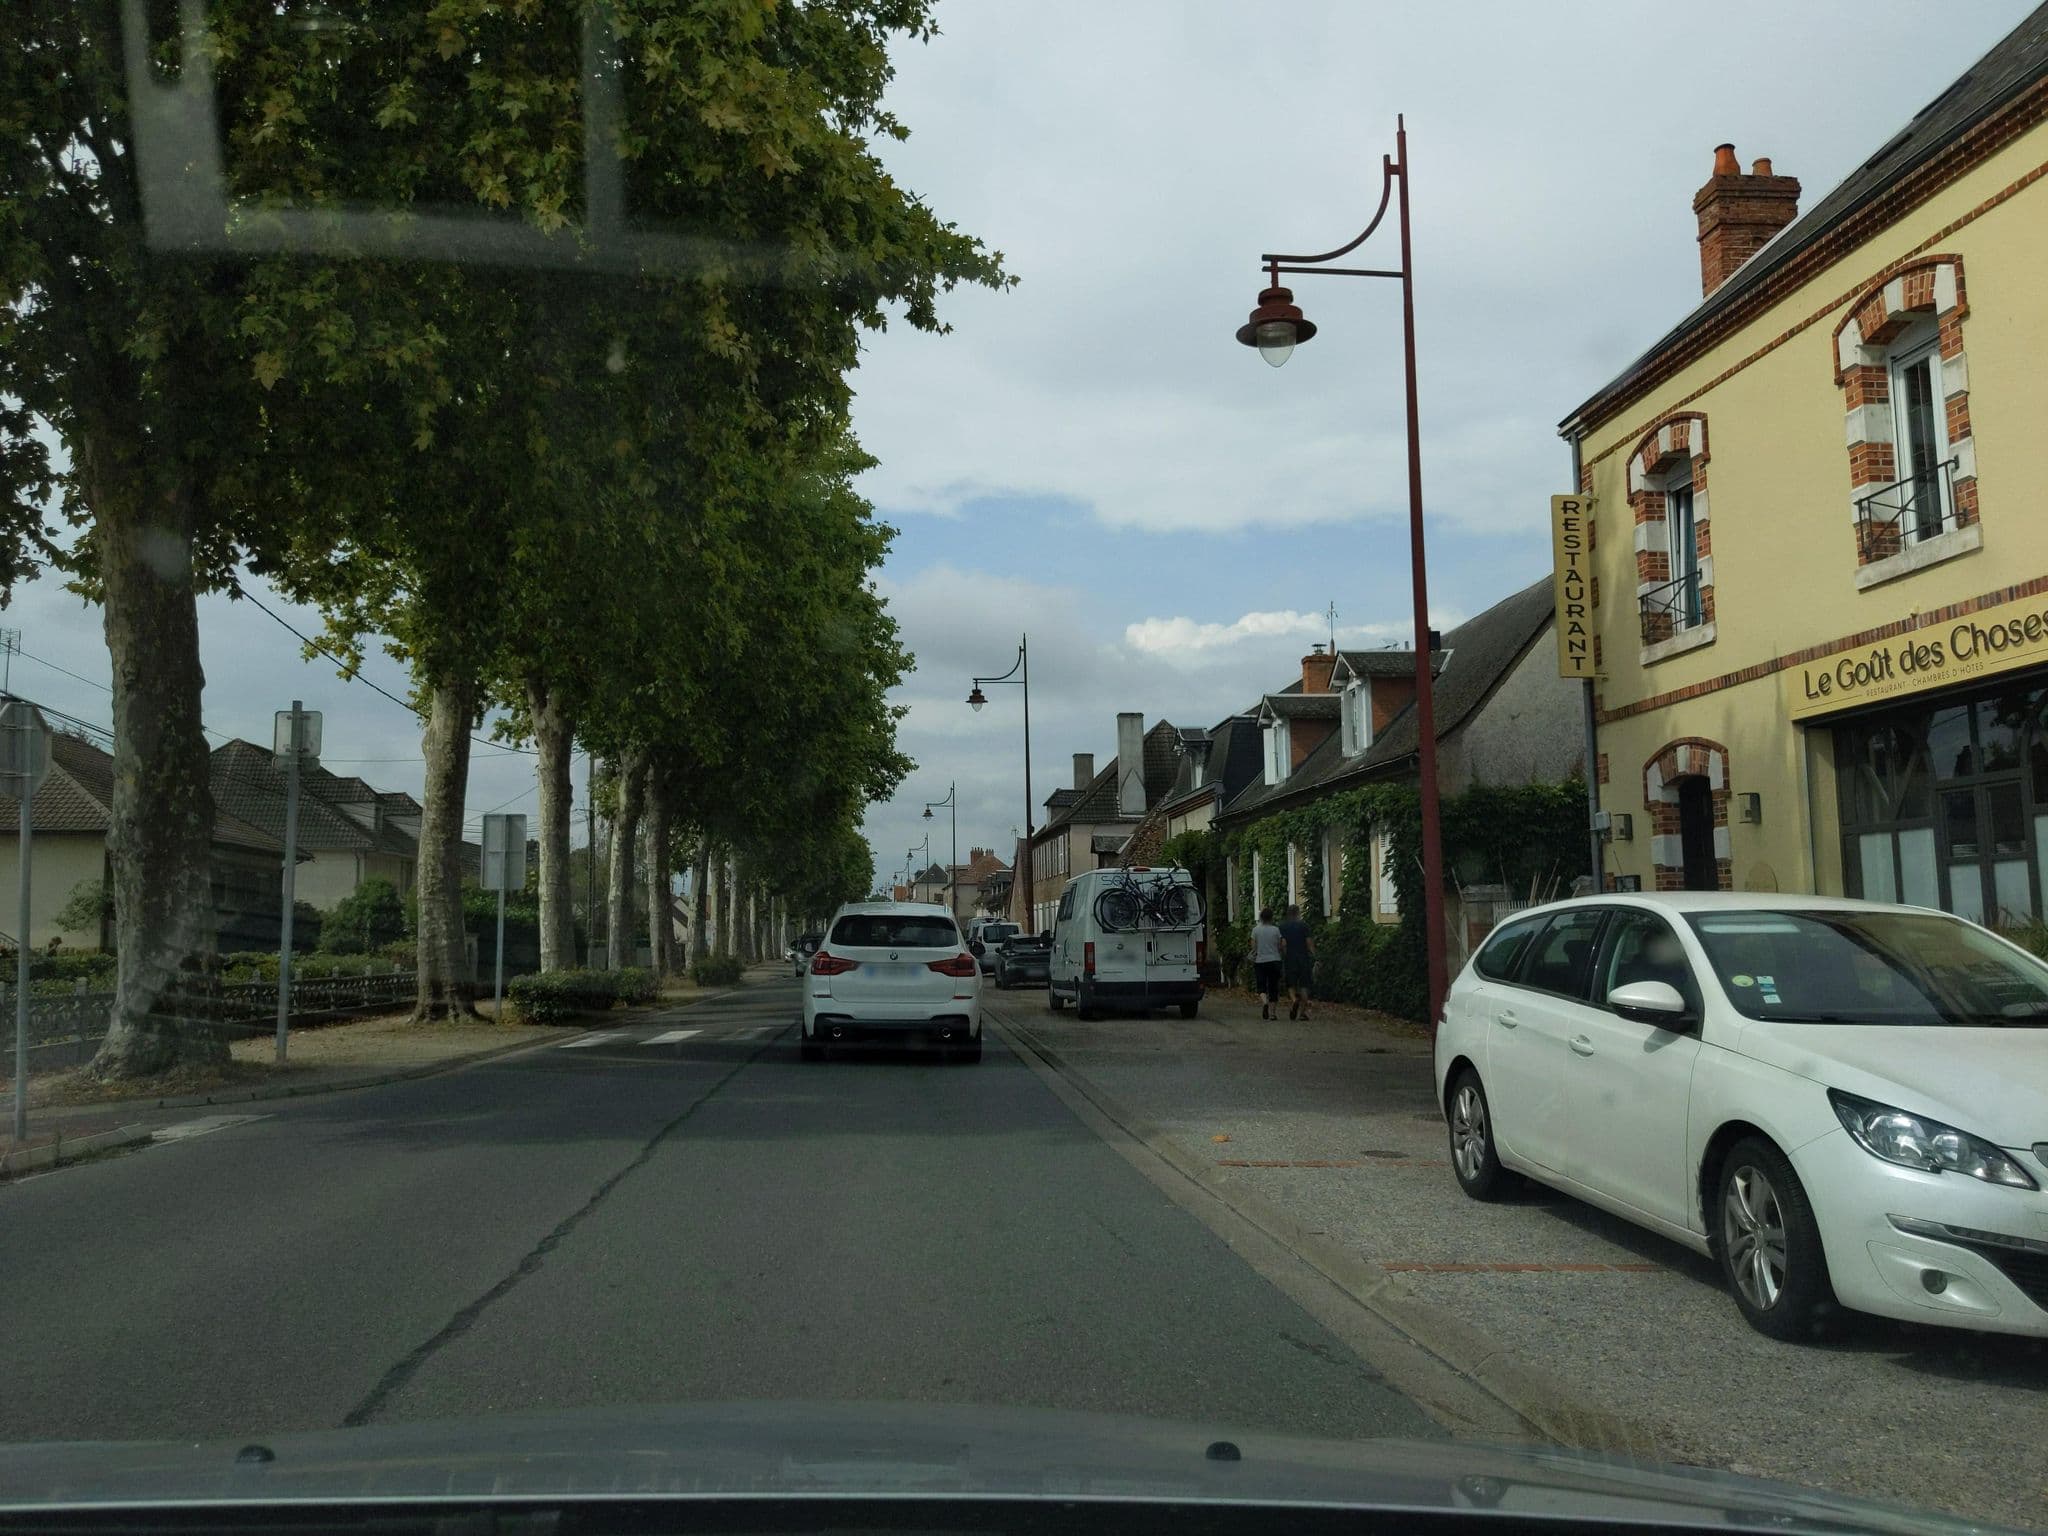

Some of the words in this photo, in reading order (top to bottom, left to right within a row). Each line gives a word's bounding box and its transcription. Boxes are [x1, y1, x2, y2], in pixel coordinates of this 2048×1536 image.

[1561, 500, 1586, 671] RESTAURANT
[1804, 670, 1832, 700] Le
[1836, 647, 1895, 691] Goût
[1899, 640, 1945, 674] des
[1866, 681, 1906, 697] RESTAURANT
[1912, 670, 1950, 687] CHAMBRES
